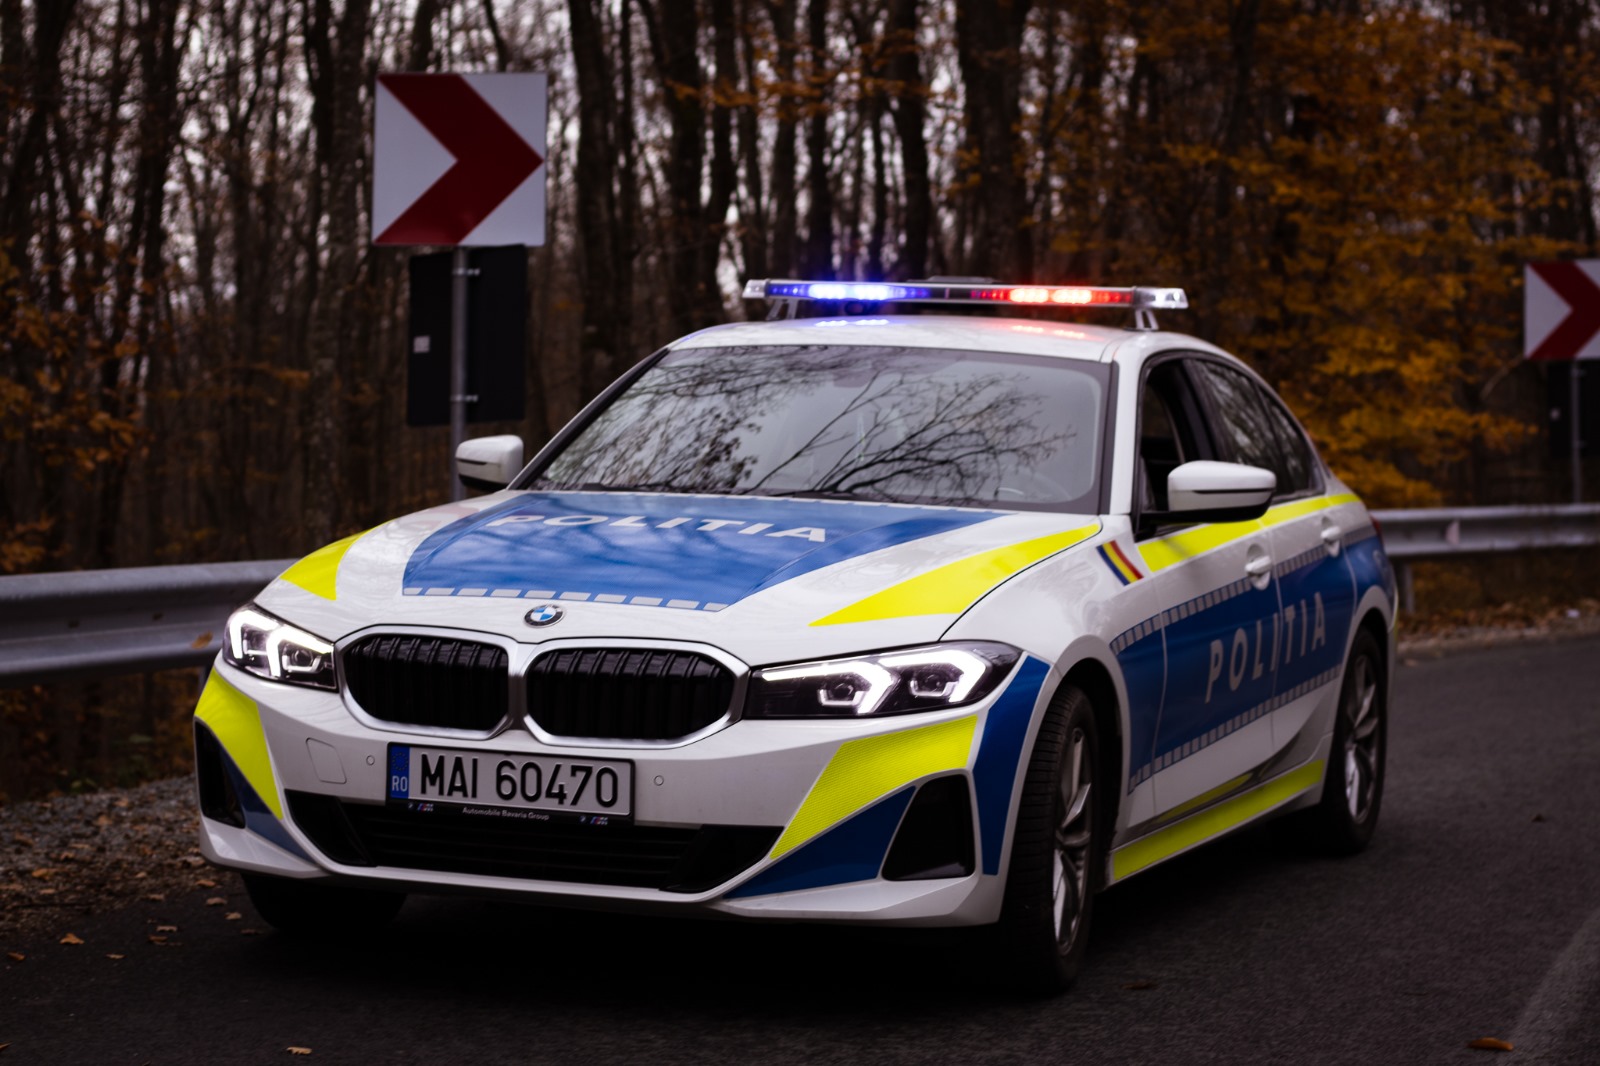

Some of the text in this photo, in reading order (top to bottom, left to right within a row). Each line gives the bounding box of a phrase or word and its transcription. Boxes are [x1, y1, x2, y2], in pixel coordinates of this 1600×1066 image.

[485, 515, 826, 542] POLITIA
[1205, 591, 1326, 704] POLITIA
[392, 775, 408, 792] RO
[421, 753, 618, 808] MAI 60470
[462, 807, 550, 820] Automobile Bavaria Group
